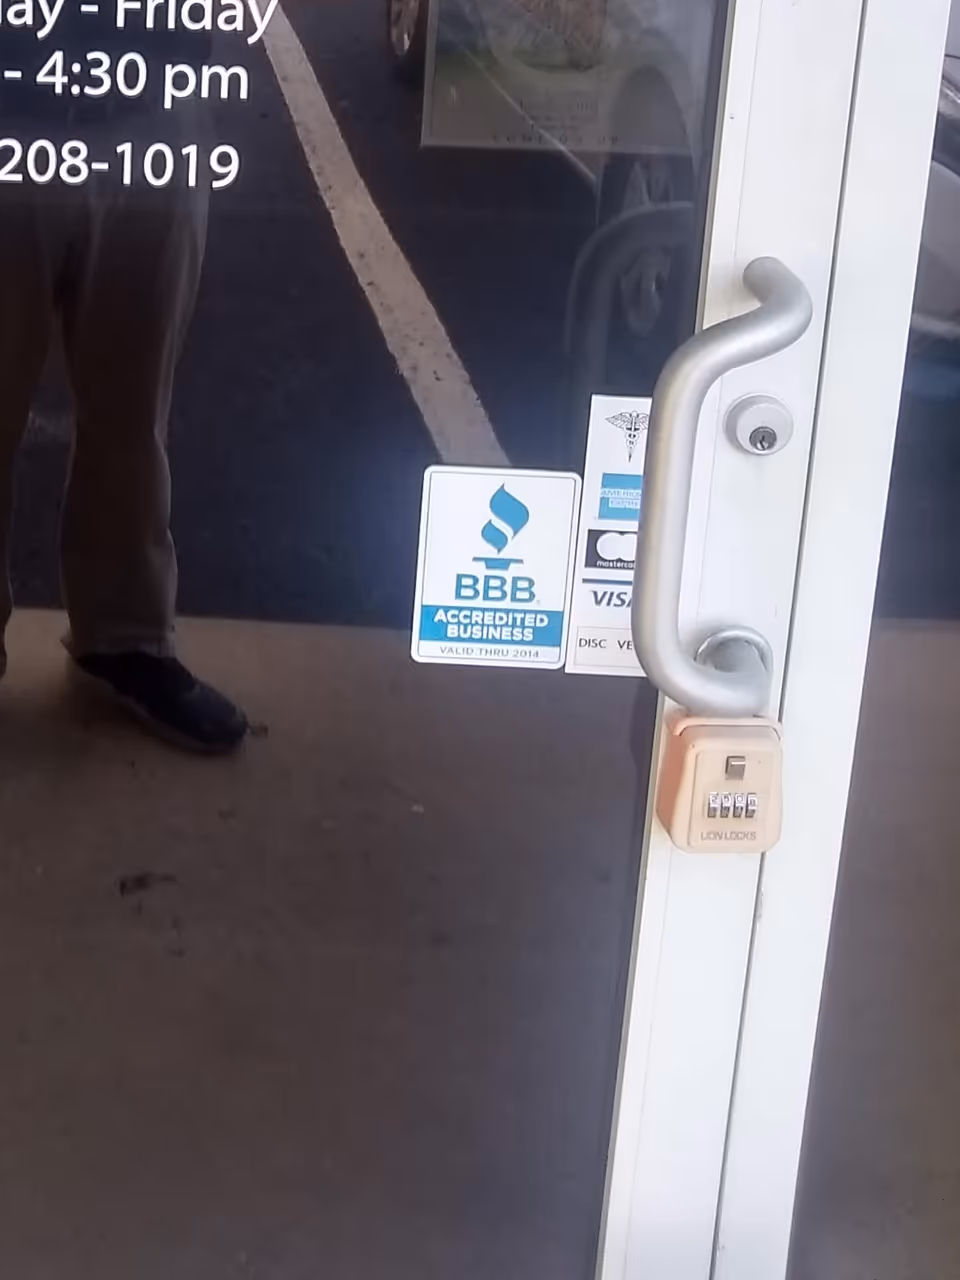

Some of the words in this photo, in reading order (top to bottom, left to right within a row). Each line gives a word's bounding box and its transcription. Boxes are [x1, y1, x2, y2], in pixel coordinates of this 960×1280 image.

[35, 50, 148, 97] 4:30
[163, 61, 250, 109] pm
[596, 560, 636, 569] masterca
[455, 573, 536, 604] BBB
[591, 590, 632, 608] VIS
[433, 608, 549, 627] ACCREDITED
[446, 624, 534, 641] BUSINESS
[439, 646, 474, 656] VALID
[479, 648, 510, 658] THRU
[513, 649, 540, 658] 2014
